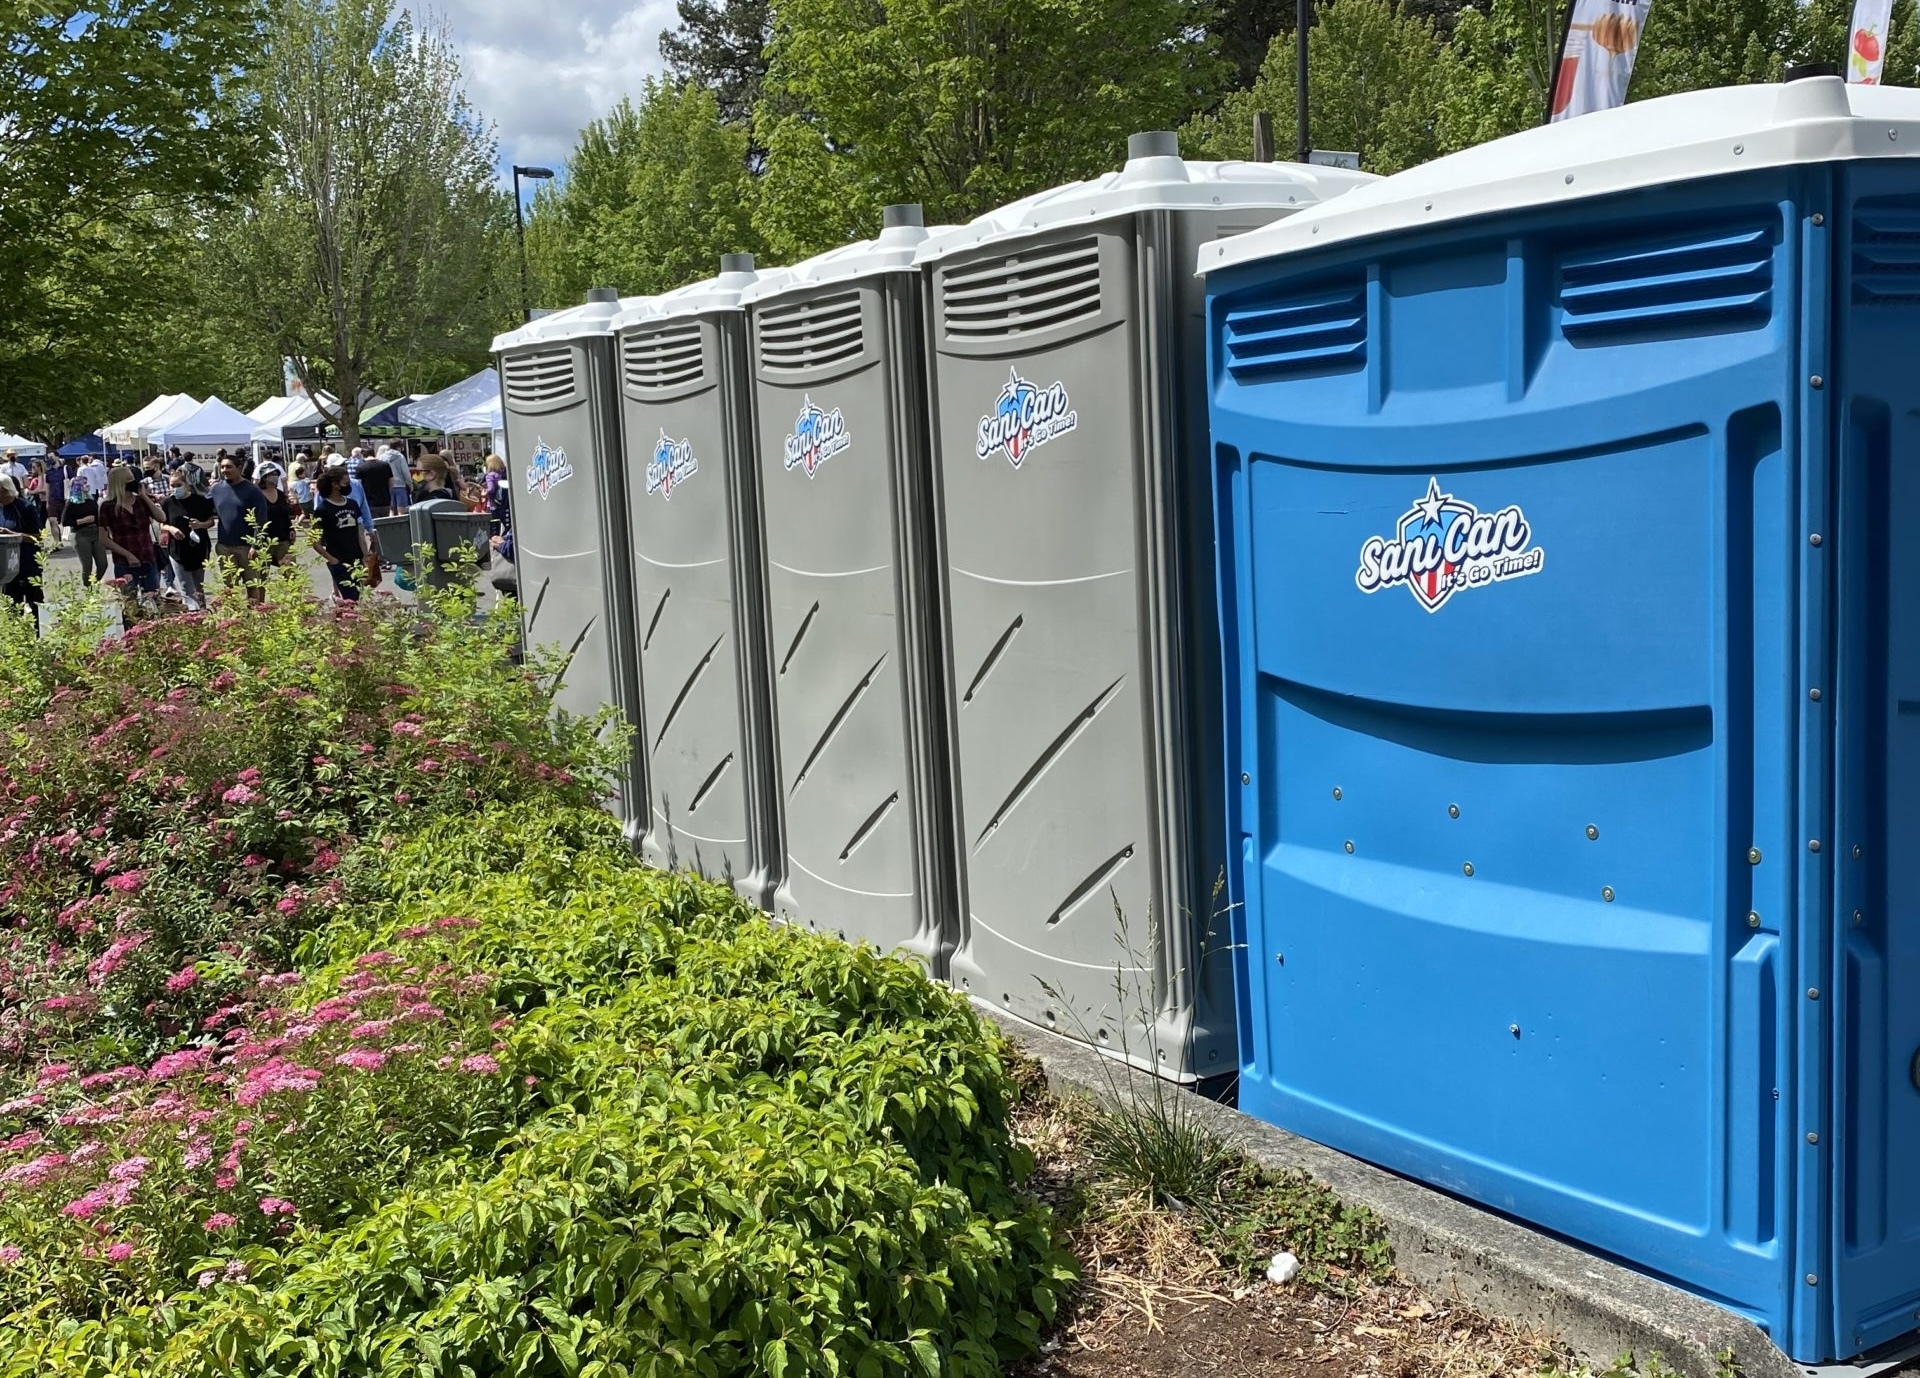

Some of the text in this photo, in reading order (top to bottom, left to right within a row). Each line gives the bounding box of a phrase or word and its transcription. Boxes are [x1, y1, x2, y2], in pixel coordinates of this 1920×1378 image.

[1440, 550, 1541, 591] It's Go Time!
